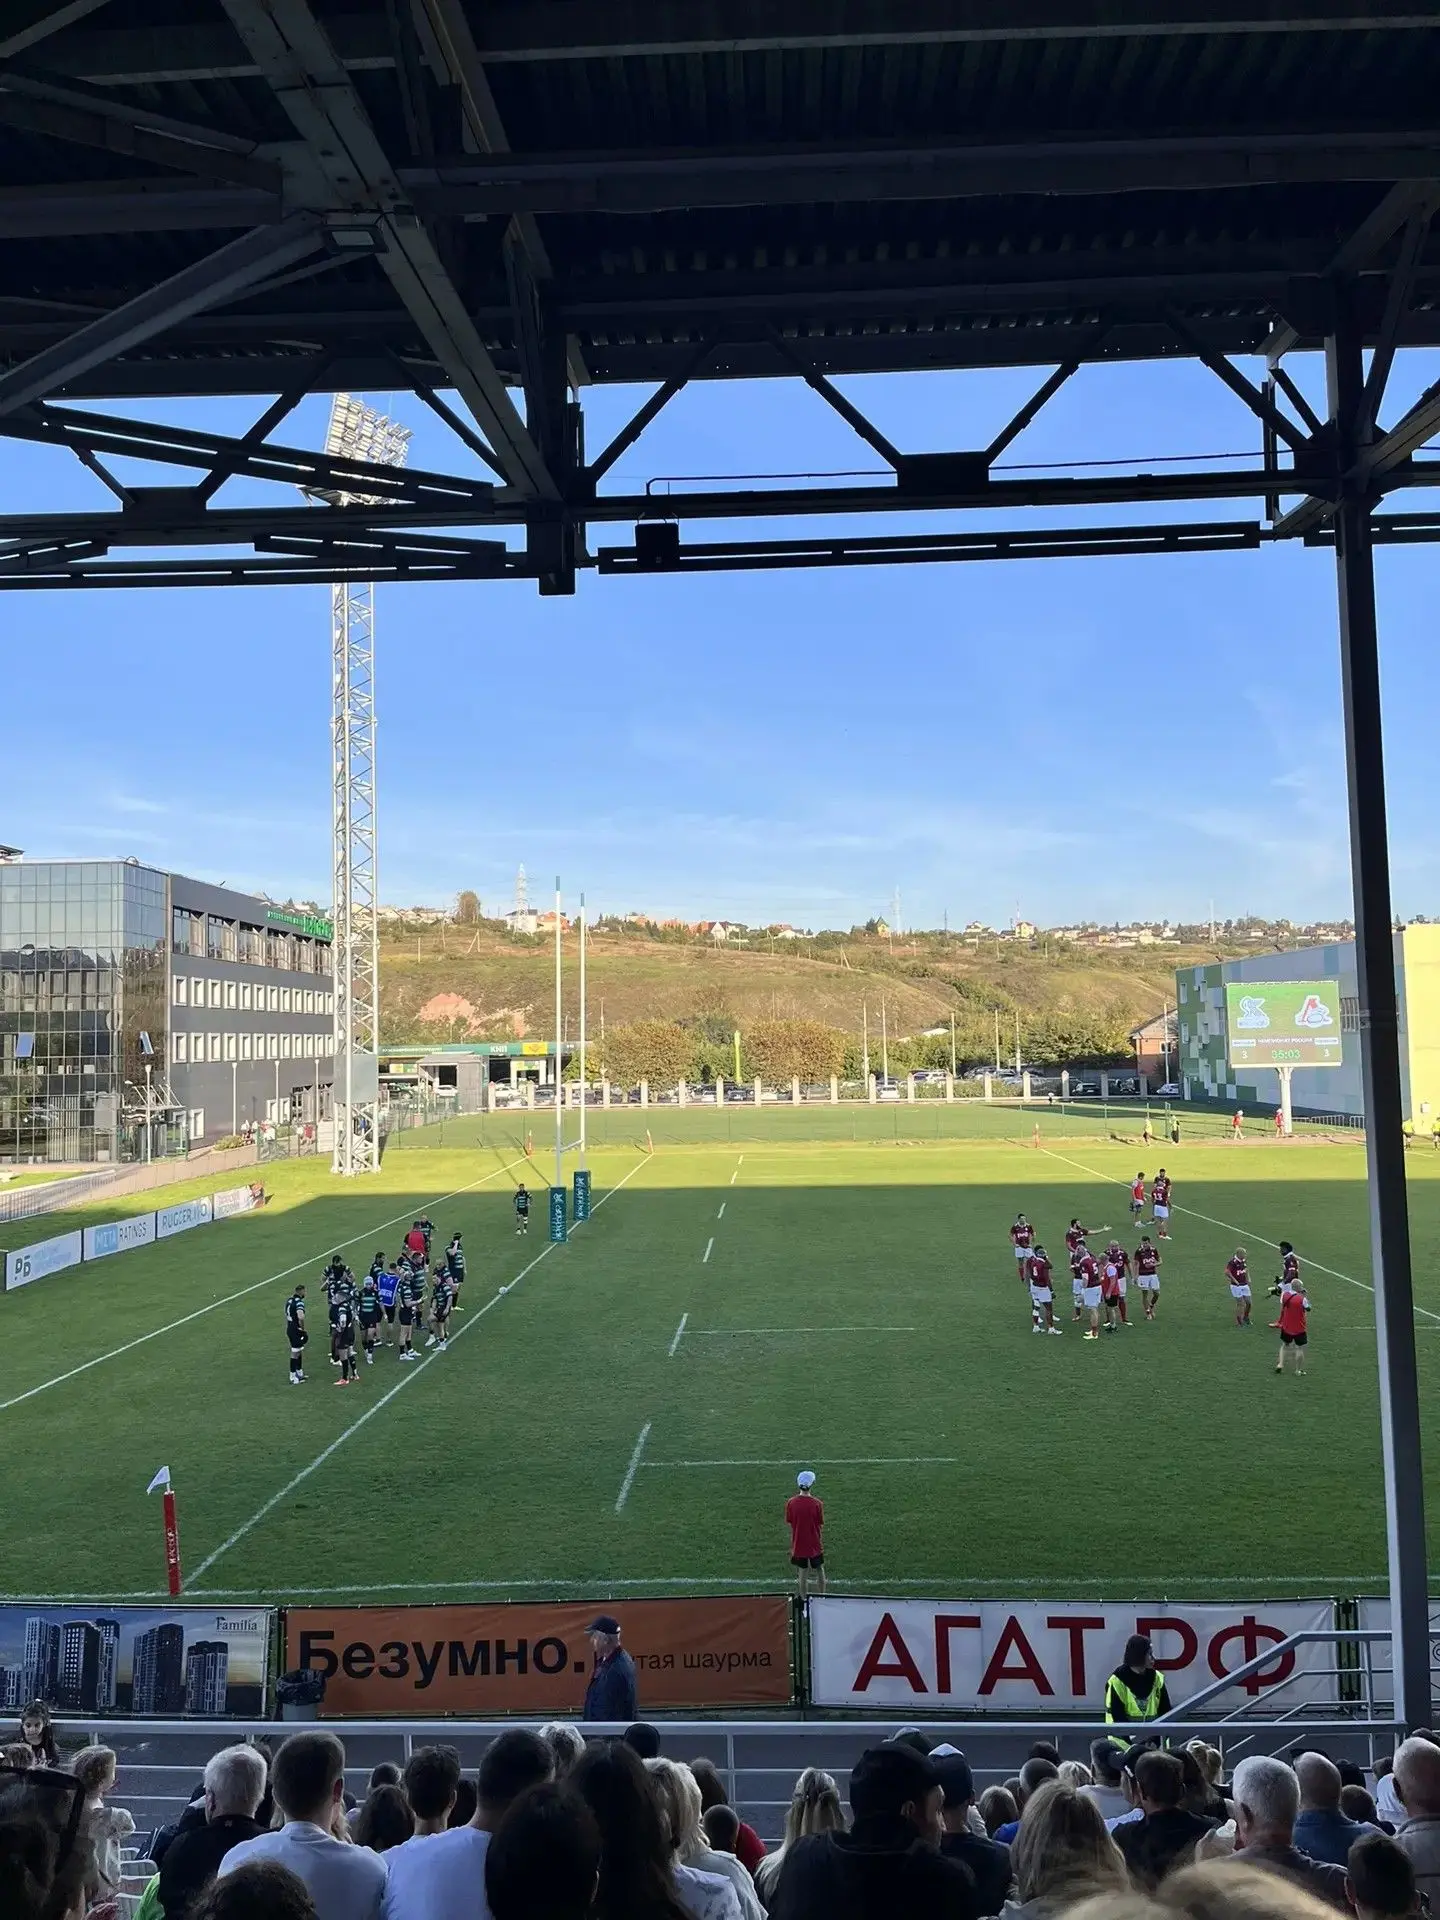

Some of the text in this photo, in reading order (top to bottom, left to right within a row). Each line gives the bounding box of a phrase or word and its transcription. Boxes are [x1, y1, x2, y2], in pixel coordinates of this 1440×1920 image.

[216, 1616, 258, 1630] Familia
[299, 1630, 585, 1689] Безумно.
[683, 1651, 772, 1673] шаурма
[852, 1612, 1106, 1696] АГАТ
